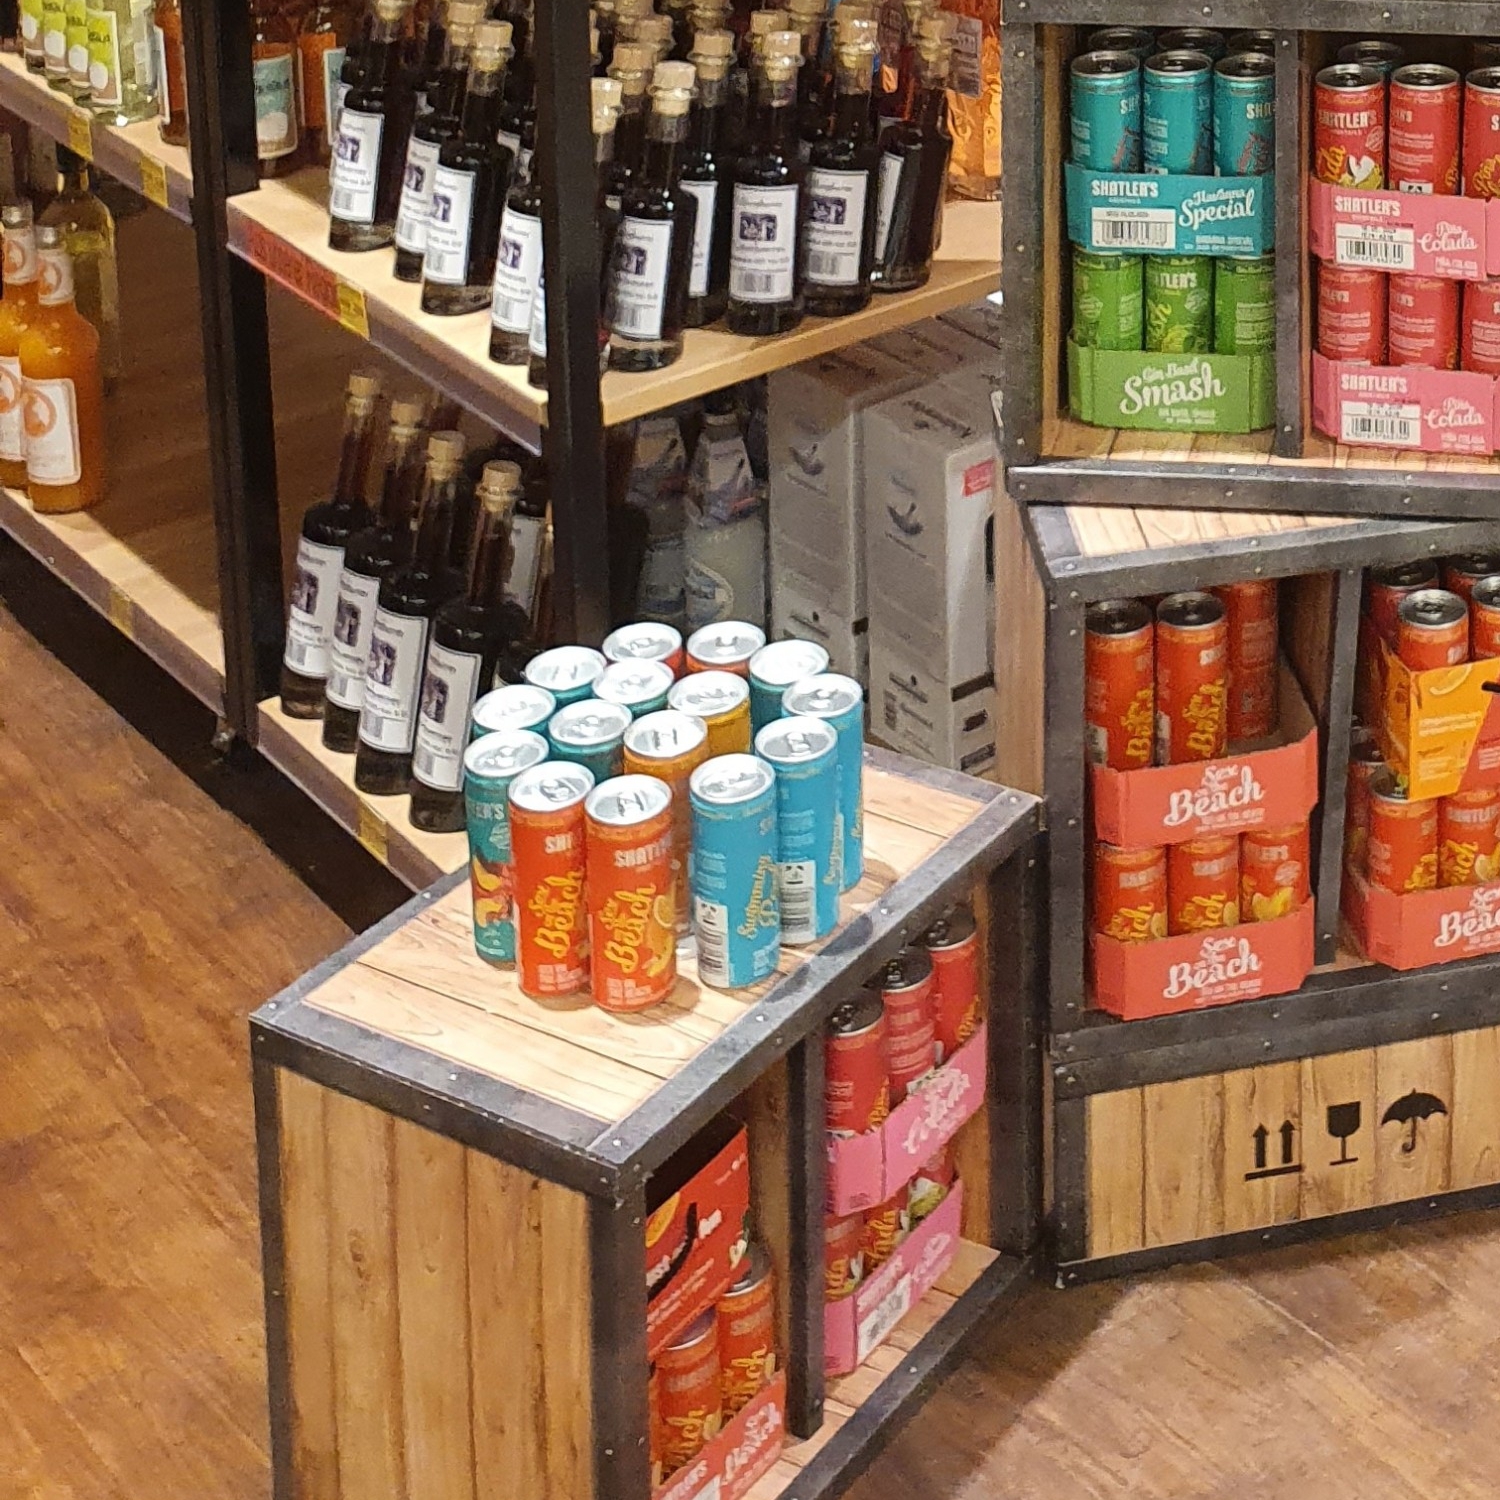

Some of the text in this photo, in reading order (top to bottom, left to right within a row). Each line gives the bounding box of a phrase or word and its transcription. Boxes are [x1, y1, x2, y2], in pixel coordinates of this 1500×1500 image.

[1091, 179, 1159, 198] SHATLER'S
[1178, 186, 1256, 230] Special
[1334, 195, 1401, 217] SHATLER'S
[1416, 232, 1480, 254] Colada
[1119, 361, 1227, 415] Smash
[1340, 373, 1408, 394] SHATLER'S
[1424, 406, 1486, 430] Colada
[1163, 765, 1265, 827] Beach
[532, 868, 586, 960] Beach
[603, 881, 658, 974] Beach
[1162, 937, 1262, 999] Beach
